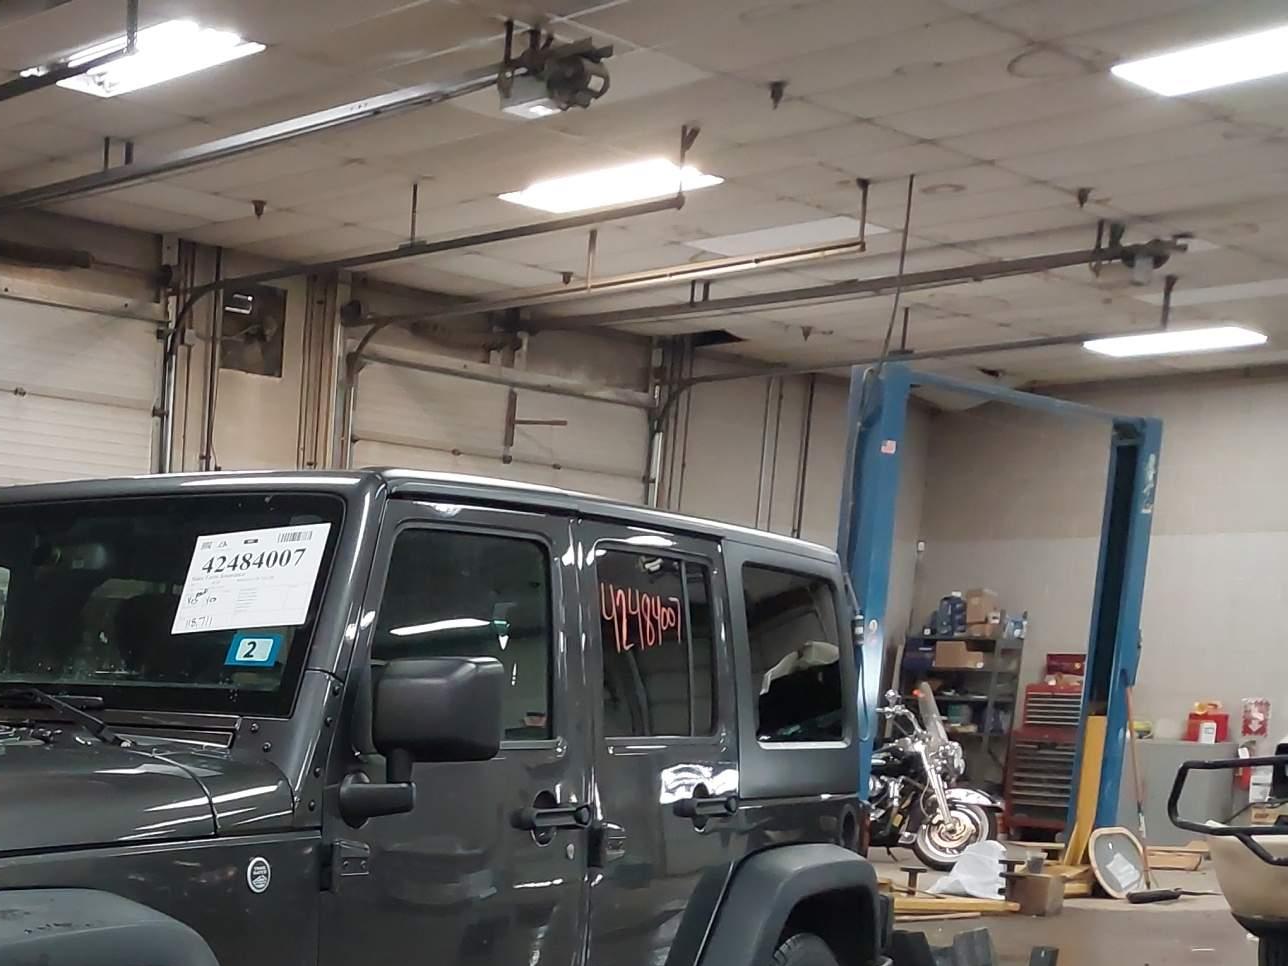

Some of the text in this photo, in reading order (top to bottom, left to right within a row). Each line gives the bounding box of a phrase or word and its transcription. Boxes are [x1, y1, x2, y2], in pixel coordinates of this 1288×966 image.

[202, 547, 307, 574] 42484007
[600, 582, 681, 653] 42484007
[243, 641, 257, 658] 2
